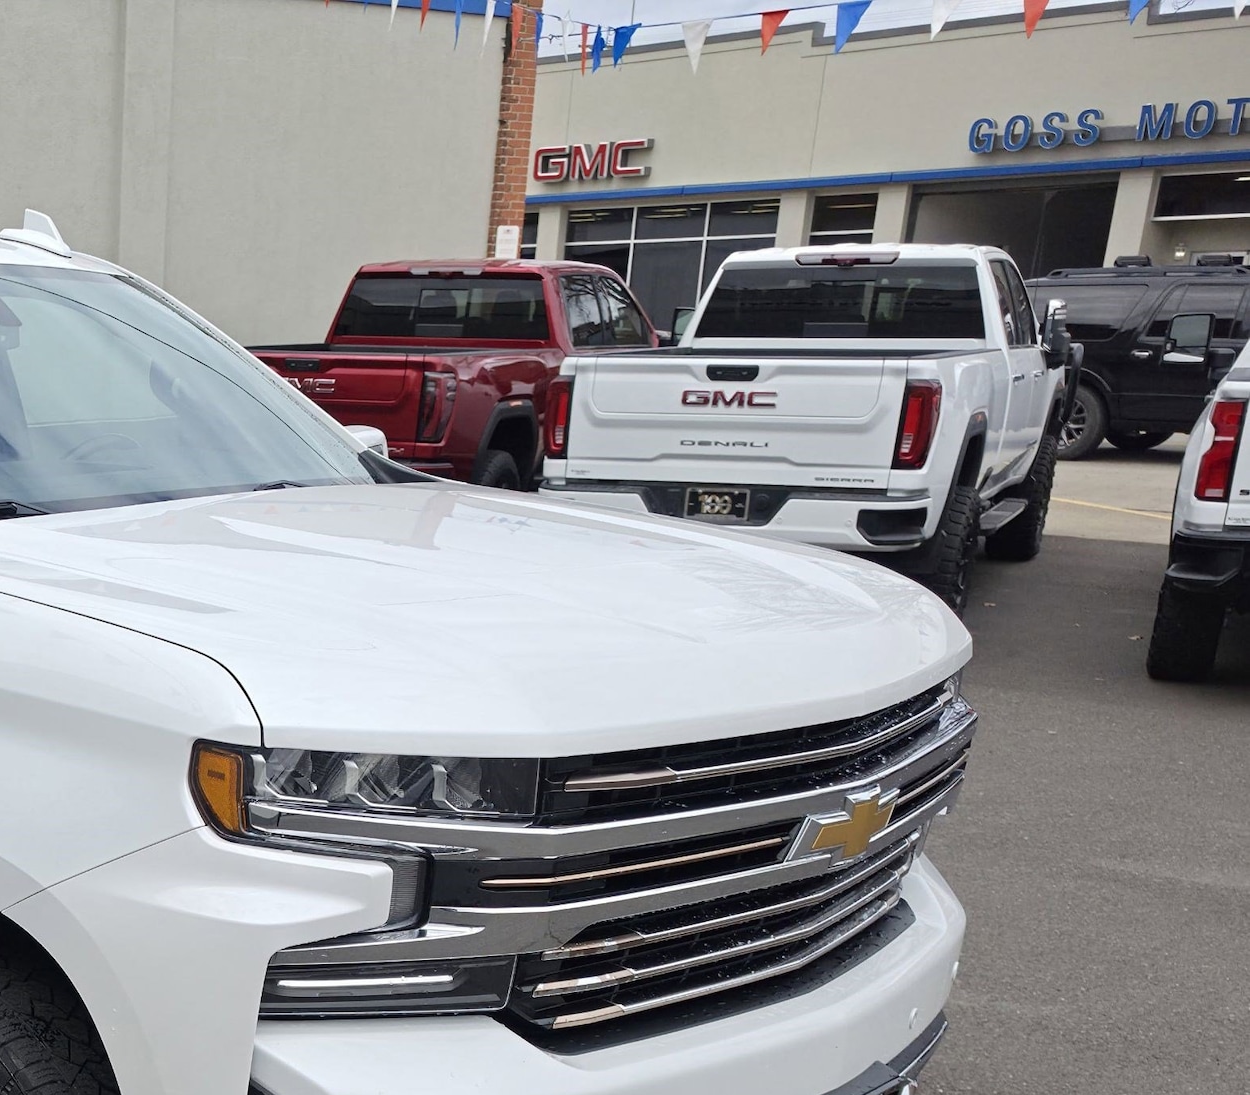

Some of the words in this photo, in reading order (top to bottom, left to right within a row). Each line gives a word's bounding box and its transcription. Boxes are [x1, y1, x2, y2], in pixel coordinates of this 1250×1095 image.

[968, 107, 1102, 154] GOSS
[1135, 96, 1250, 142] MOT
[533, 138, 654, 183] GMC
[282, 377, 337, 394] MC
[681, 390, 778, 409] GMC
[680, 439, 769, 448] DENALI
[814, 476, 875, 484] SIERRA
